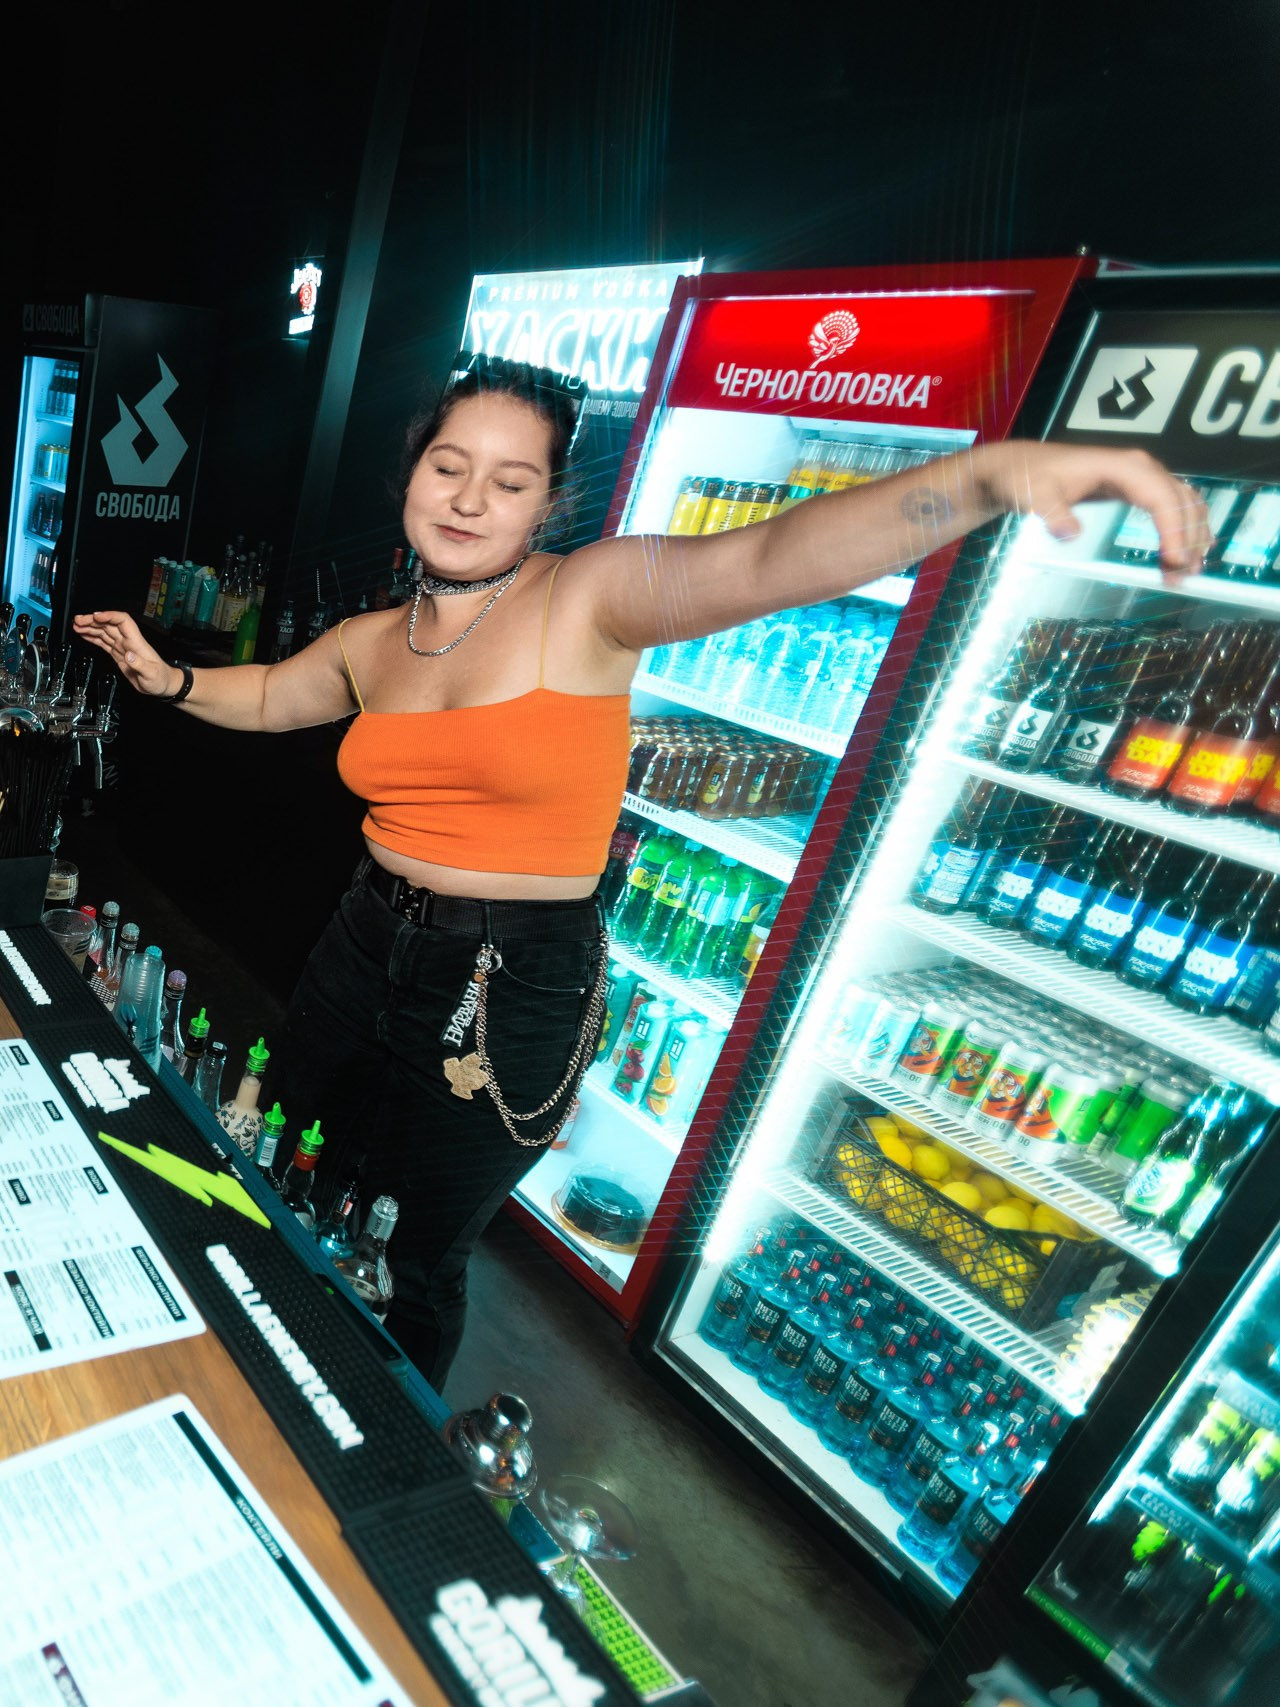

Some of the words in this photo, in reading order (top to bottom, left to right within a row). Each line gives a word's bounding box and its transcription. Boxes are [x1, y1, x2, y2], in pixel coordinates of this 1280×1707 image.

[715, 360, 931, 410] ЧЕРНОГОЛОВКА
[95, 491, 180, 522] СВОБОДА
[135, 1249, 159, 1279] БЕЗАЛКО
[155, 1282, 182, 1317] НАПИТКИ
[782, 1330, 805, 1349] ОЗЕР
[785, 1323, 808, 1344] ПЯТЬ
[879, 1412, 906, 1433] ОЗЕР
[882, 1404, 909, 1429] ПЯТЬ
[234, 1498, 283, 1561] КОКТЕЙЛИ
